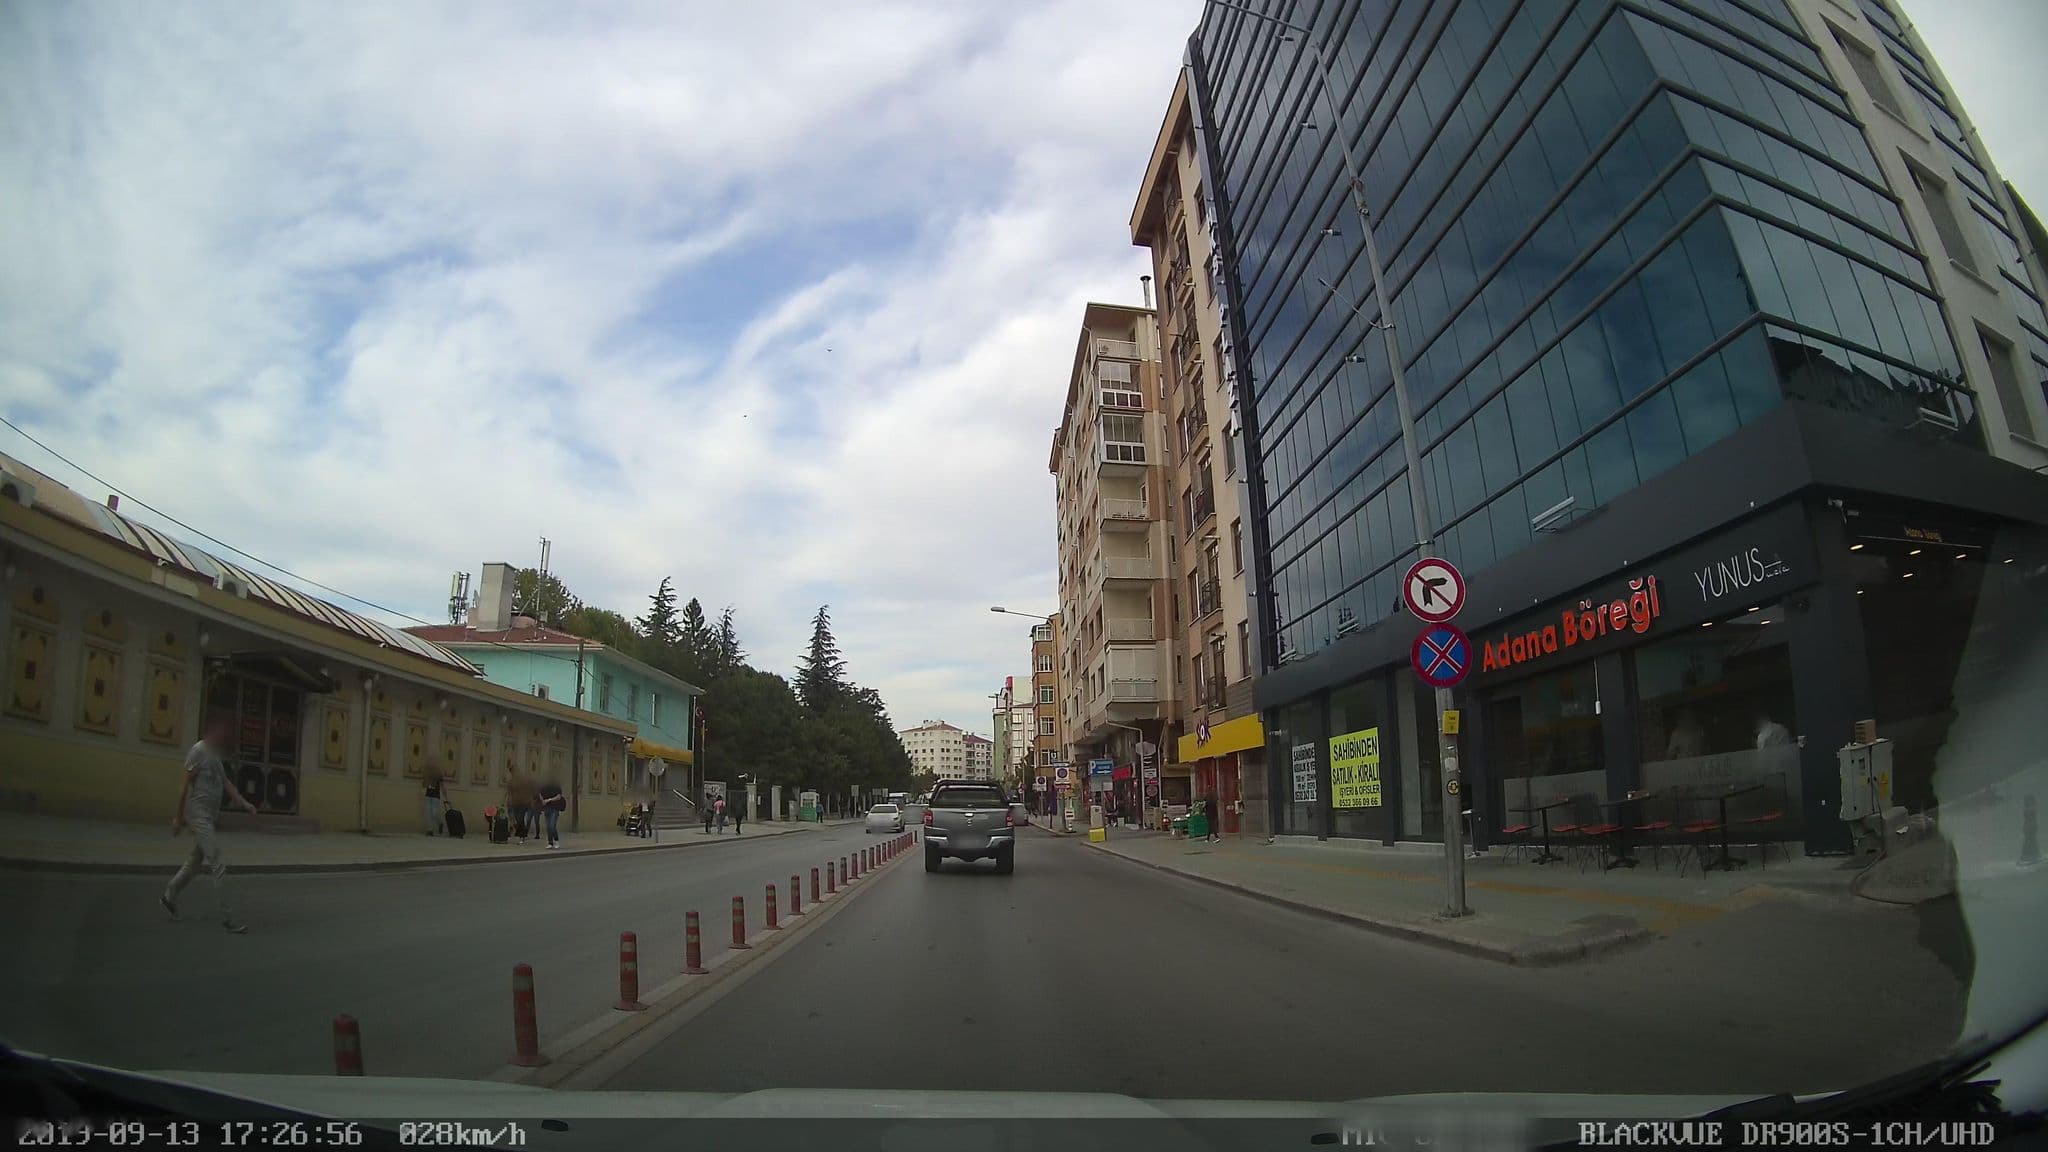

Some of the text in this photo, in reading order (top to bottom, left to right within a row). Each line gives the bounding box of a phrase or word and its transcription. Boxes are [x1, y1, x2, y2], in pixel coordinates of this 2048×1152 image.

[1694, 547, 1764, 602] YUNUS
[1483, 574, 1660, 672] Adana Böreği
[1333, 736, 1378, 761] SAHİBİNDEN
[1332, 766, 1354, 784] SATILIK
